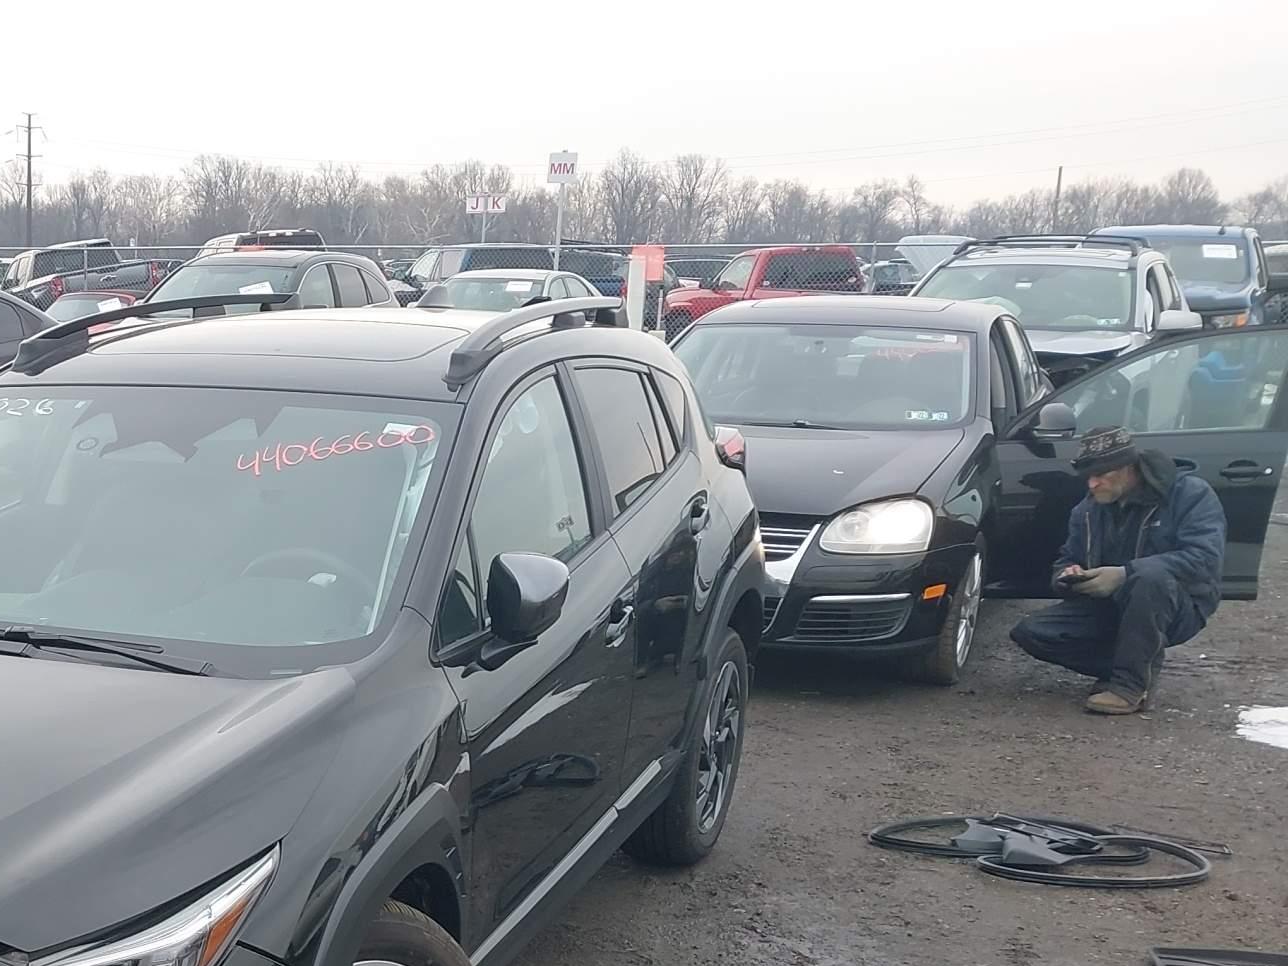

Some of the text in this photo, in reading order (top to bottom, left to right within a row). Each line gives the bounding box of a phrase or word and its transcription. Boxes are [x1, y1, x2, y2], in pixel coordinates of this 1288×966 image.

[550, 162, 574, 175] MM
[470, 197, 502, 210] J K
[236, 424, 435, 476] 44066600
